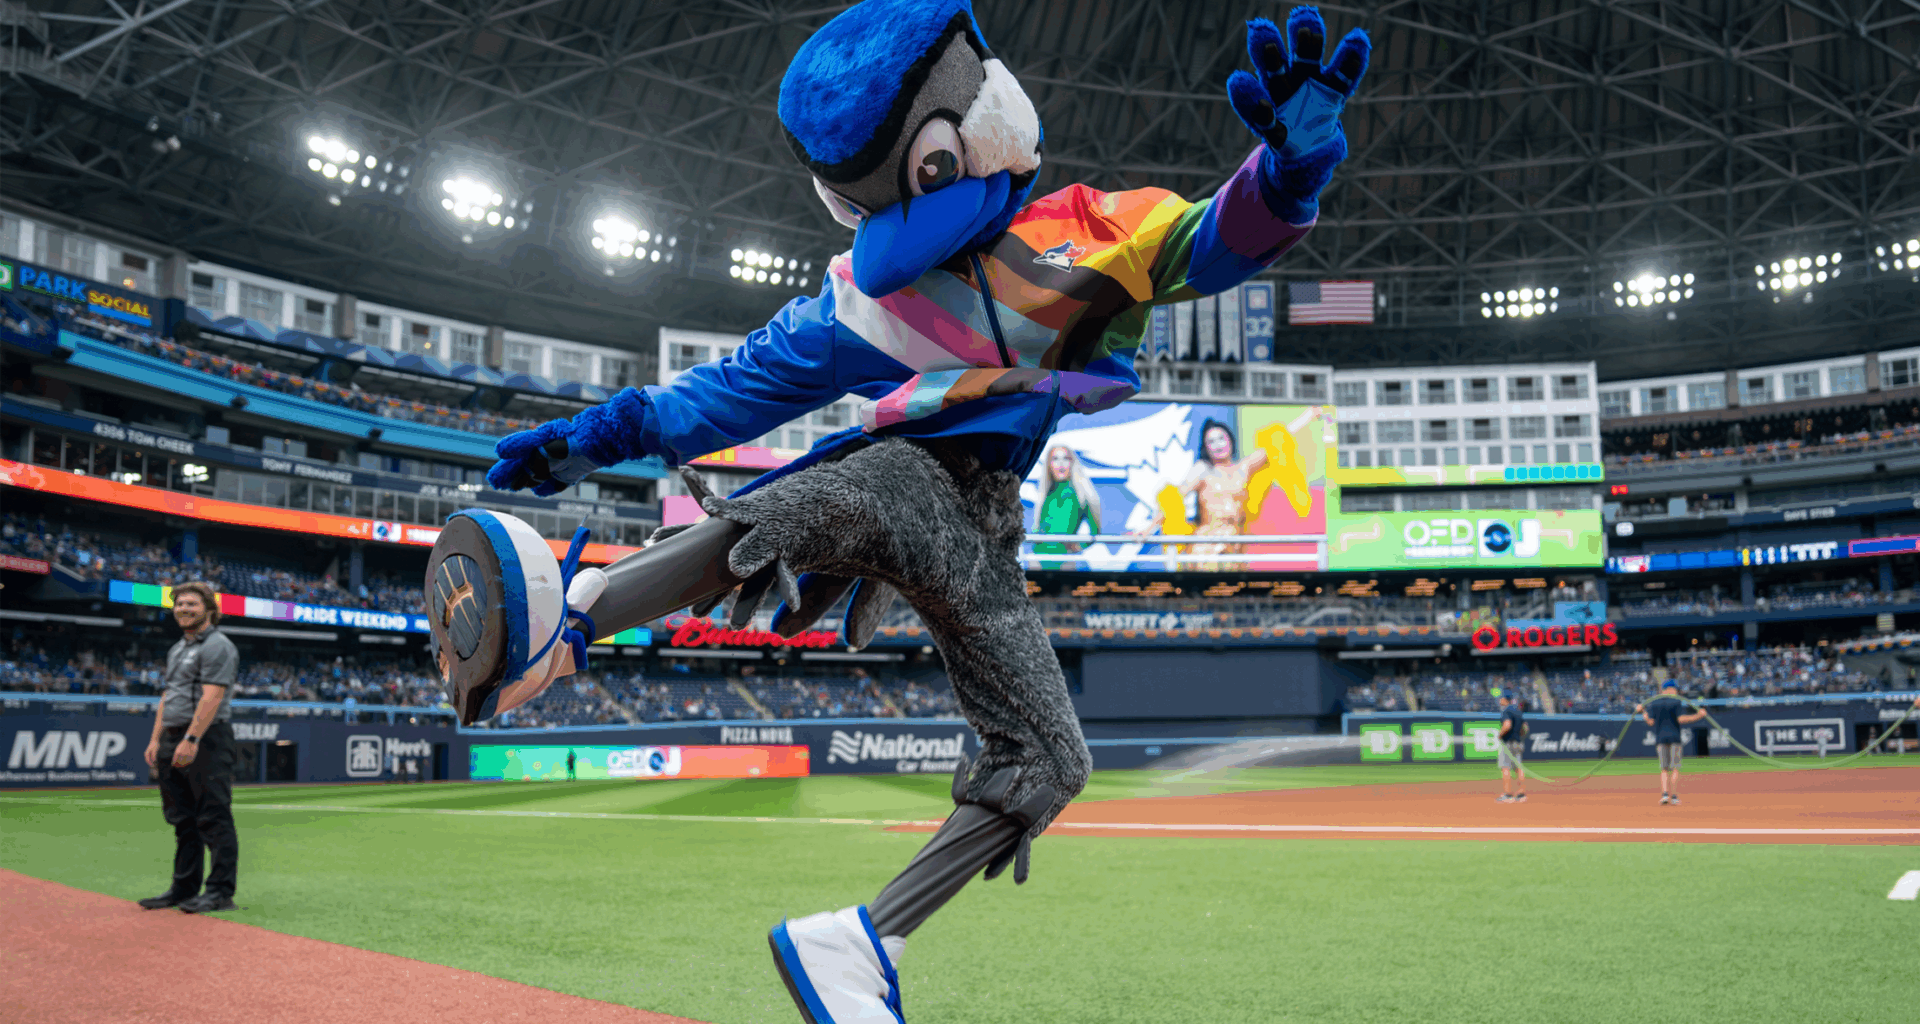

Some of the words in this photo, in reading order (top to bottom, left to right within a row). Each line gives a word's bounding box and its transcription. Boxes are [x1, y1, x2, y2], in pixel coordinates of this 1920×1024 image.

[19, 265, 87, 303] PARK
[88, 290, 150, 317] SOCIAL
[1245, 316, 1273, 337] 32
[127, 429, 156, 448] TOM
[156, 436, 194, 455] CHEEK
[293, 604, 337, 625] PRIDE
[340, 610, 407, 631] WEEKEND
[1085, 613, 1160, 630] WESTJET
[665, 613, 838, 648] Budweiser
[1506, 623, 1618, 648] ROGERS
[720, 725, 758, 744] PIZZA
[759, 726, 794, 744] NOVA
[860, 732, 965, 760] National
[1530, 732, 1560, 752] Tim
[1765, 729, 1798, 742] THE
[7, 730, 127, 769] MNP
[47, 770, 91, 782] Business
[91, 769, 118, 781] Takes
[896, 760, 919, 773] Car
